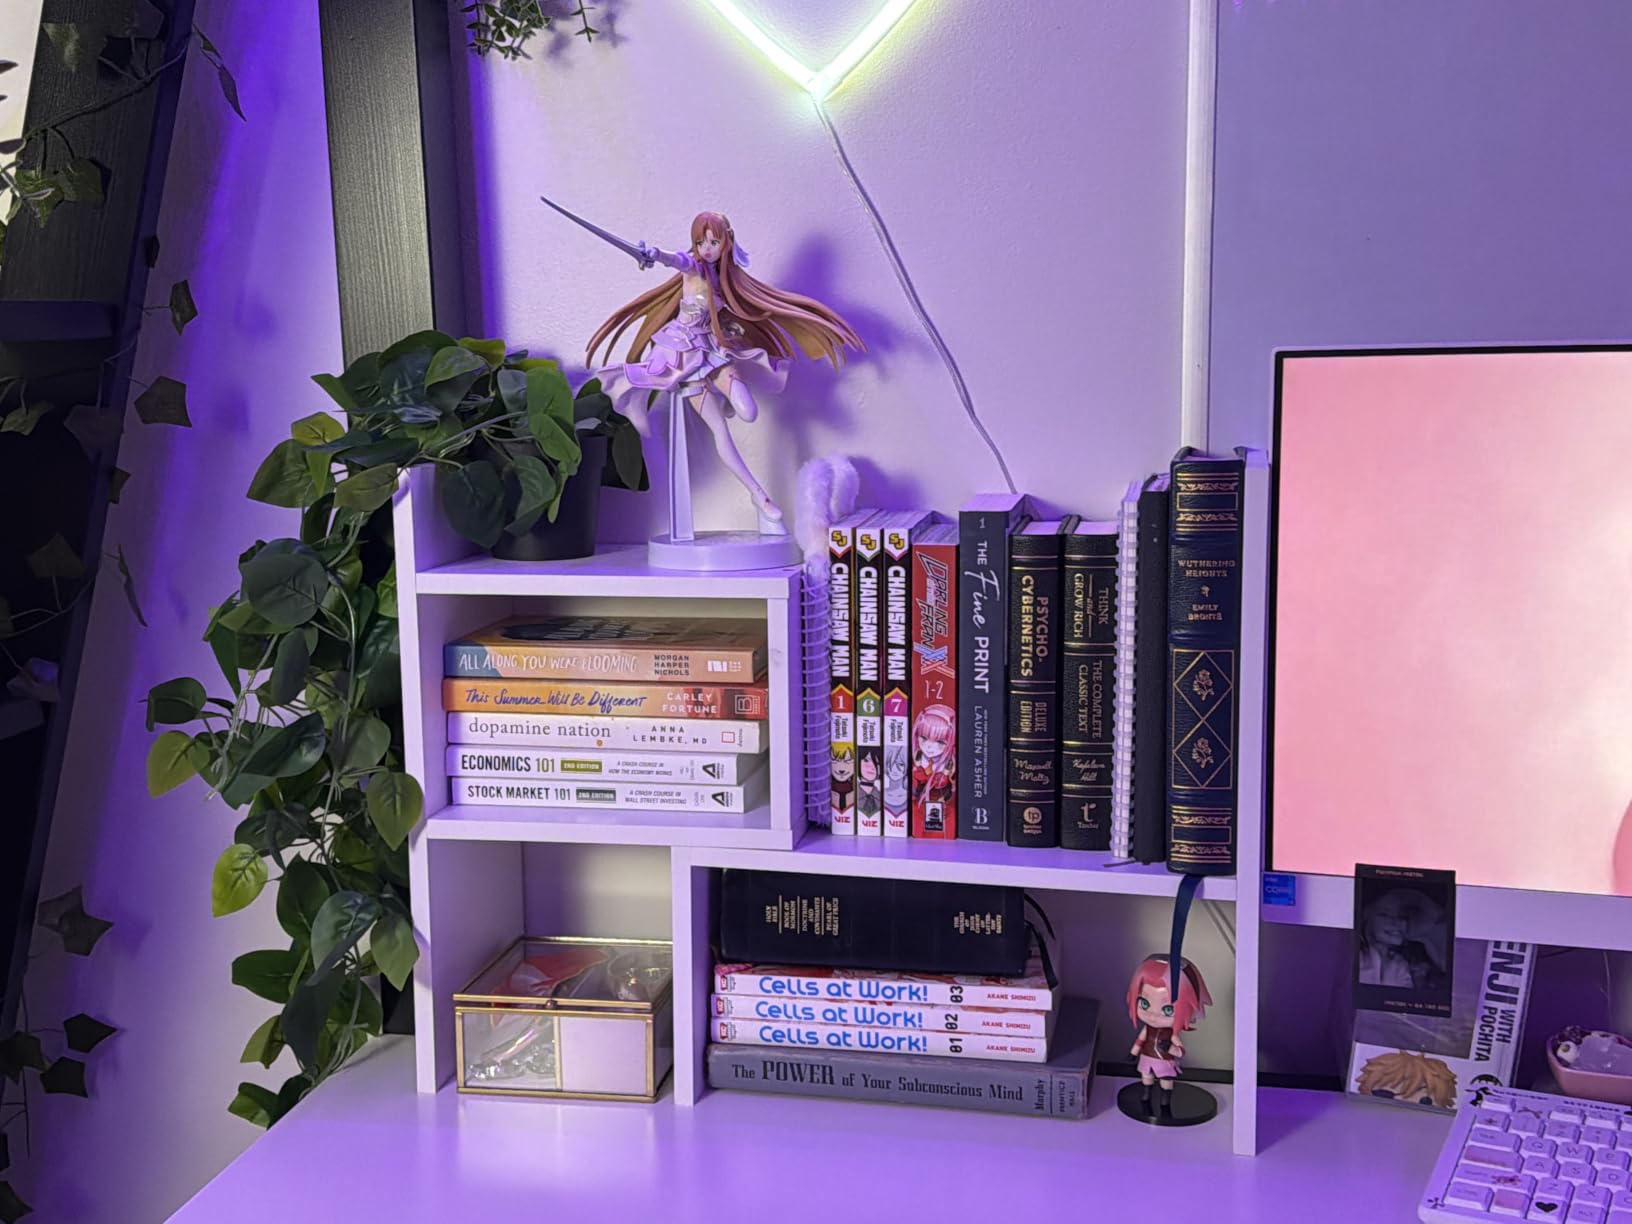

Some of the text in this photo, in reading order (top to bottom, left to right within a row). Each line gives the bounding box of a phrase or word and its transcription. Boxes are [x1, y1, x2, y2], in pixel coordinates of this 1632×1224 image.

[979, 518, 985, 529] 1
[1177, 560, 1236, 568] WUTHERING
[916, 551, 948, 637] DARLING
[1073, 572, 1084, 638] GROW RICH
[1087, 598, 1096, 616] and
[1098, 587, 1109, 625] THINK
[831, 562, 850, 677] CHAINSAW MAN
[860, 566, 878, 681] CHAINSAW MAN
[887, 565, 906, 680] CHAINSAW MAN
[964, 541, 1000, 693] THE Fine PRINT
[1020, 575, 1034, 677] CYBERNETICS
[1036, 596, 1048, 662] PSYCHO-
[459, 654, 637, 673] ALL ALONG YOU WERE BLOOMING
[667, 692, 713, 702] CARLEY
[924, 680, 944, 700] 1-2
[1078, 664, 1088, 732] CLASSIC TEXT
[1092, 660, 1103, 739] THE COMPLETE
[465, 688, 647, 714] This Summer Will Be Different
[662, 704, 717, 714] FORTUNE
[838, 695, 845, 709] 1
[862, 698, 875, 713] 6
[890, 698, 902, 712] 7
[1020, 700, 1032, 733] EDITION
[1034, 702, 1047, 732] DELUXE
[469, 717, 611, 738] dopamine nation
[633, 734, 688, 744] LEMBKE,
[974, 706, 983, 798] LAUREN ASHER
[461, 754, 556, 773] ECONOMICS 101
[1014, 758, 1053, 770] Maxwell
[1020, 771, 1050, 785] Maltz
[468, 785, 571, 801] STOCK MARKET 101
[591, 792, 614, 800] EDITION
[975, 807, 988, 824] B
[1484, 941, 1527, 1006] ENJI
[759, 976, 928, 1002] Cells at Work!
[950, 985, 963, 1004] 03
[1010, 994, 1036, 1002] SHIMIZU
[755, 1001, 815, 1021] Cells
[822, 1006, 848, 1023] at
[854, 1006, 923, 1028] Work!
[944, 1013, 958, 1030] 02
[982, 1020, 1031, 1030] AKANE SHIMIZU
[1474, 1005, 1498, 1062] POCHITA
[1495, 1009, 1516, 1044] WITH
[759, 1026, 928, 1052] Cells at Work!
[949, 1037, 963, 1053] 01
[986, 1044, 1008, 1052] AKANE
[732, 1060, 1023, 1101] The POWER of Your Subconscious Mind
[1034, 1079, 1047, 1110] Murphy
[1058, 1080, 1066, 1112] PRENTICE
[1068, 1091, 1076, 1107] HALL
